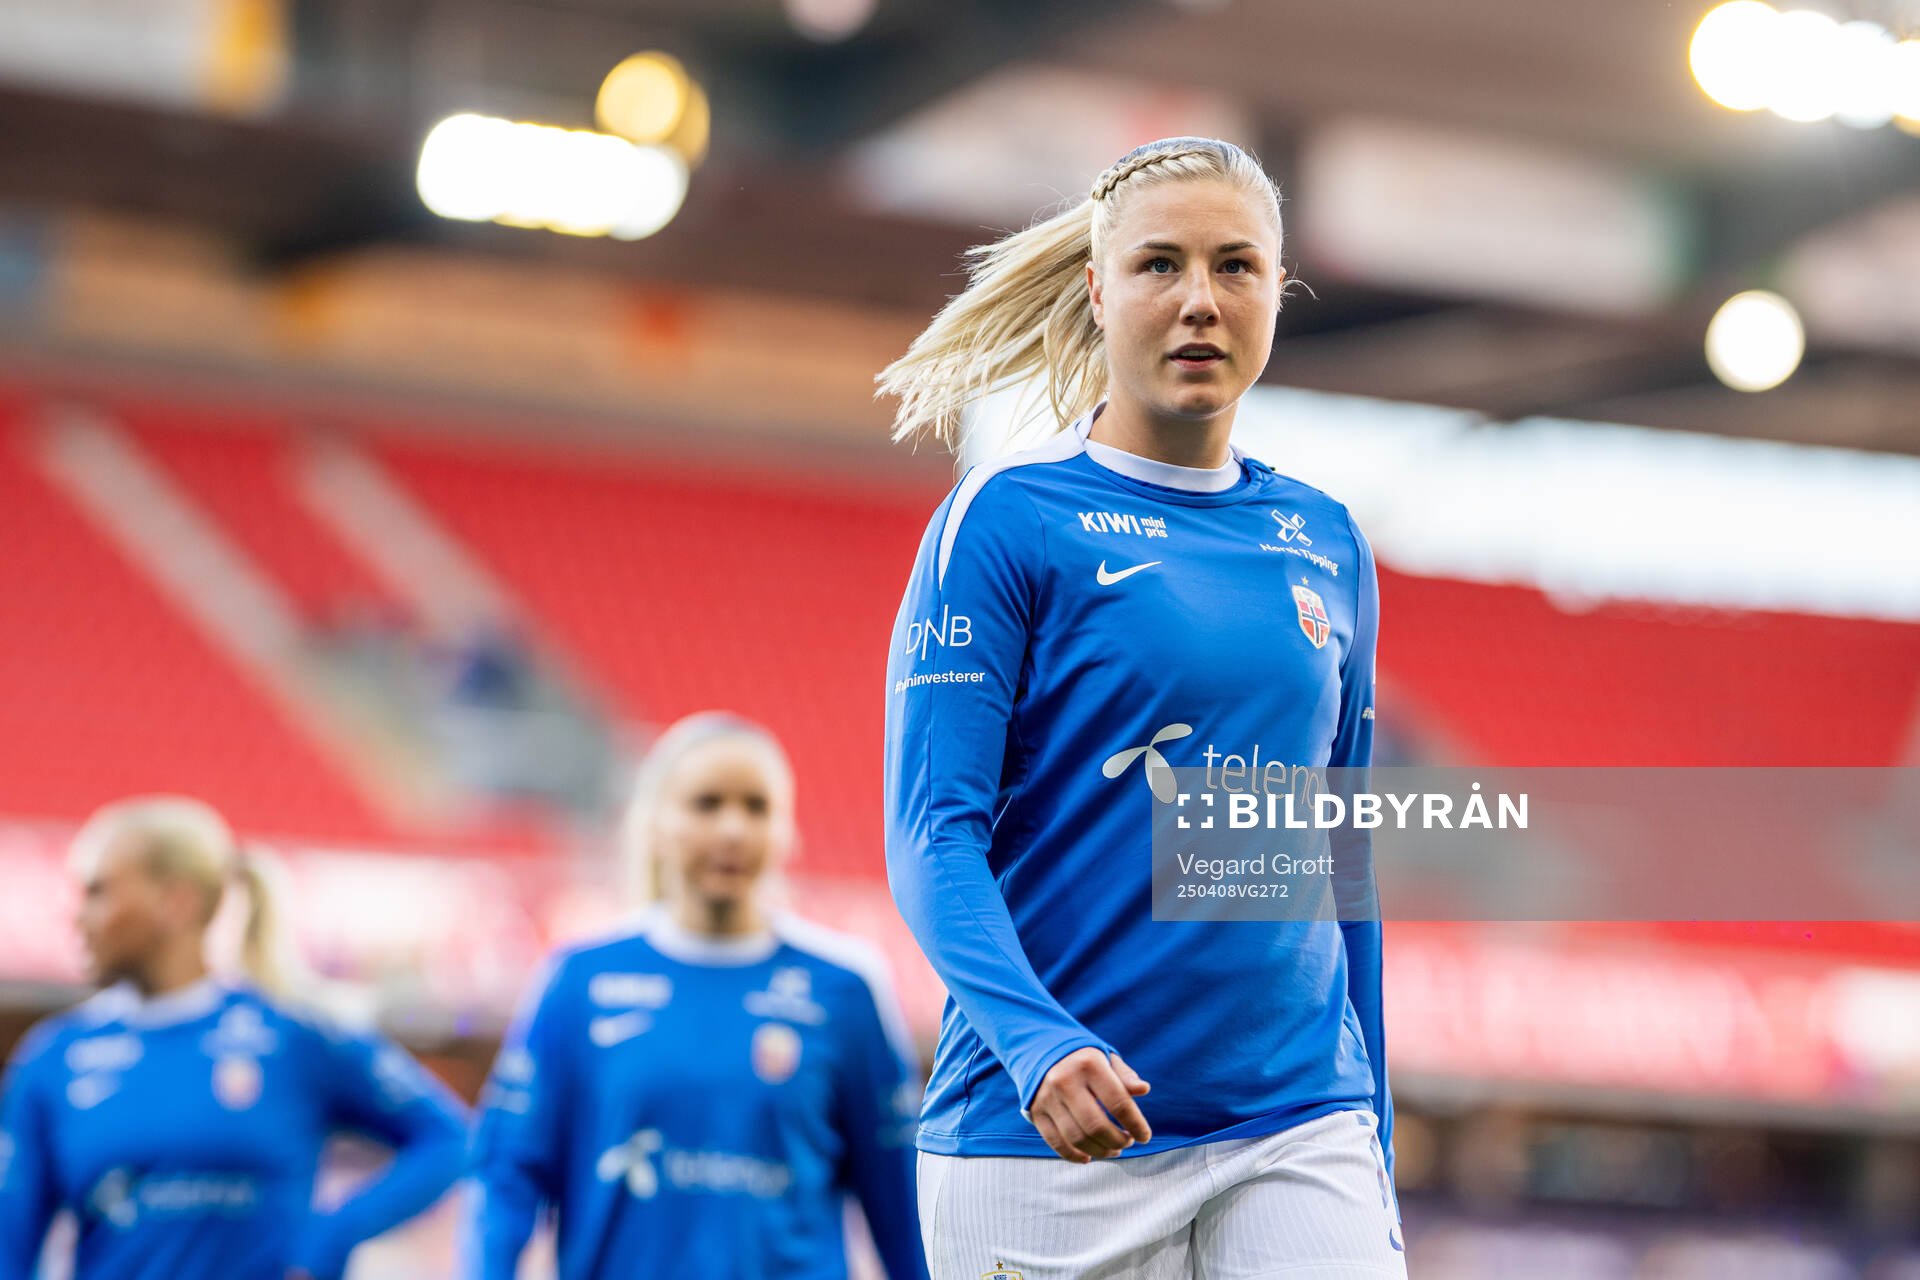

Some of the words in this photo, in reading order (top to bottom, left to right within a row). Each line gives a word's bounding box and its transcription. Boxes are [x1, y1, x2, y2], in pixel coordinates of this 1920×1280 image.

[1077, 511, 1142, 536] KIWI
[1140, 516, 1167, 529] mini
[1144, 527, 1168, 539] pris
[1299, 548, 1338, 576] Tipping
[905, 604, 972, 661] DNB
